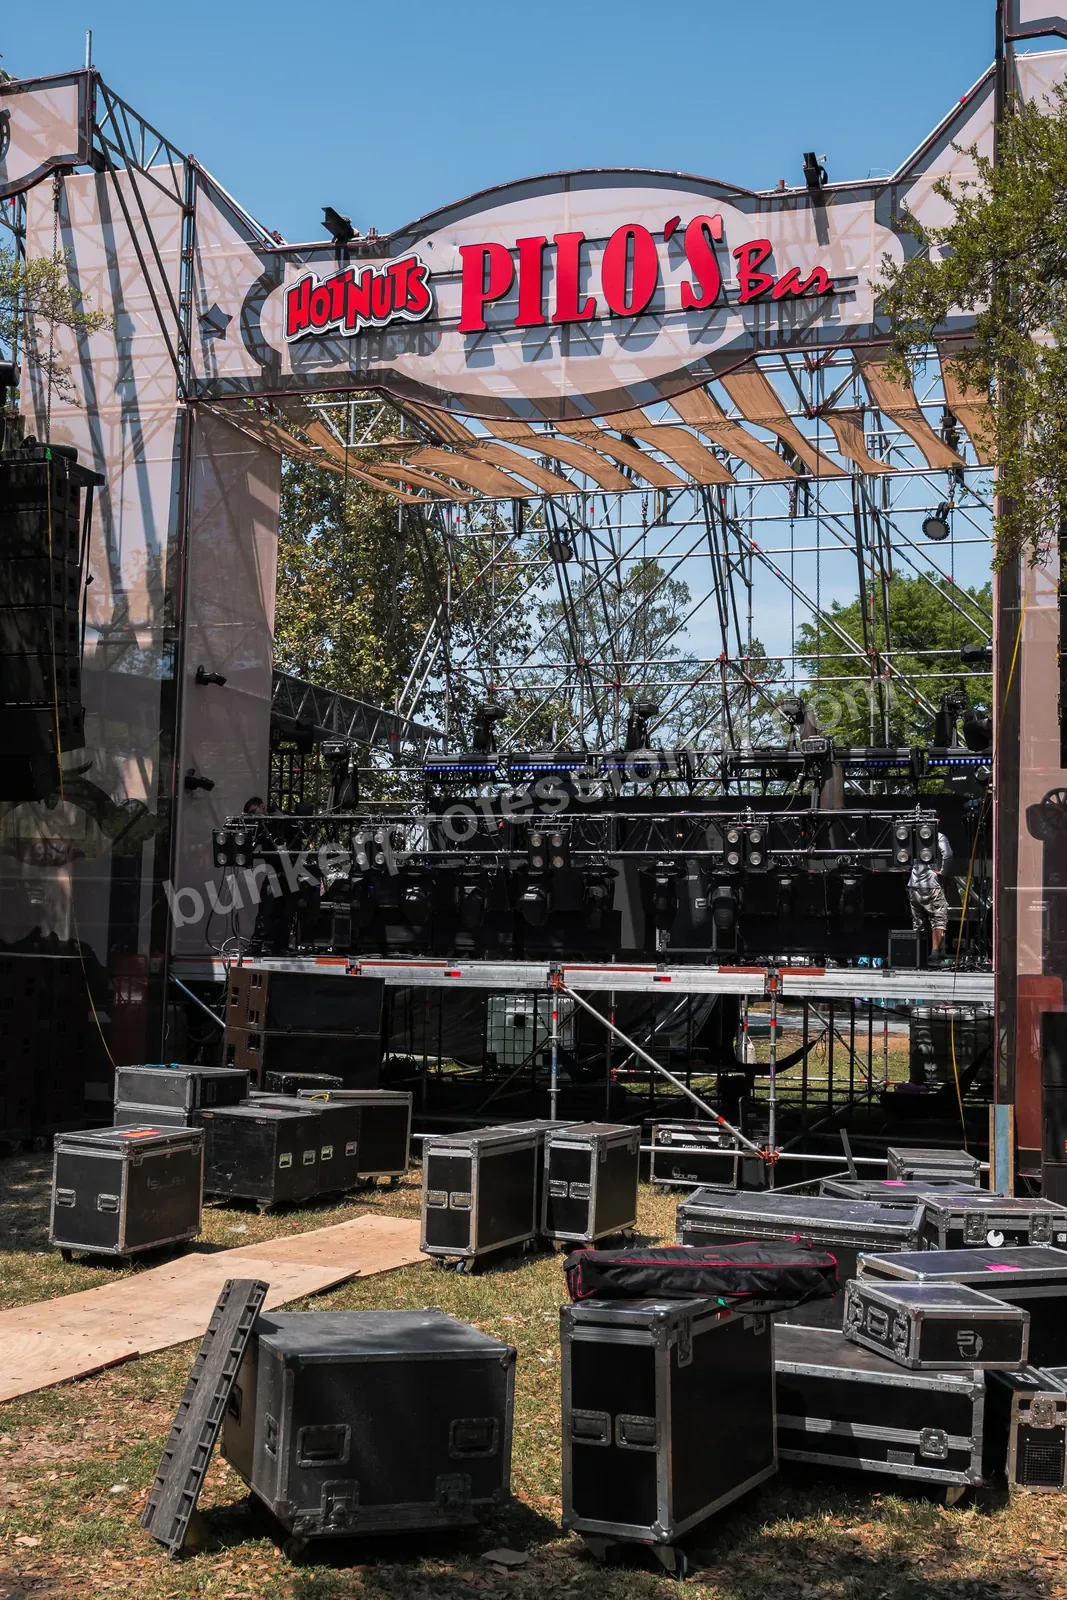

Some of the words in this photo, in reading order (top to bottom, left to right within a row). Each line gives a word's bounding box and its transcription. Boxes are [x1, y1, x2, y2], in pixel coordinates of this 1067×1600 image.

[284, 253, 432, 342] HOTNUTS
[457, 214, 723, 334] PILO'S
[732, 239, 834, 304] Bar
